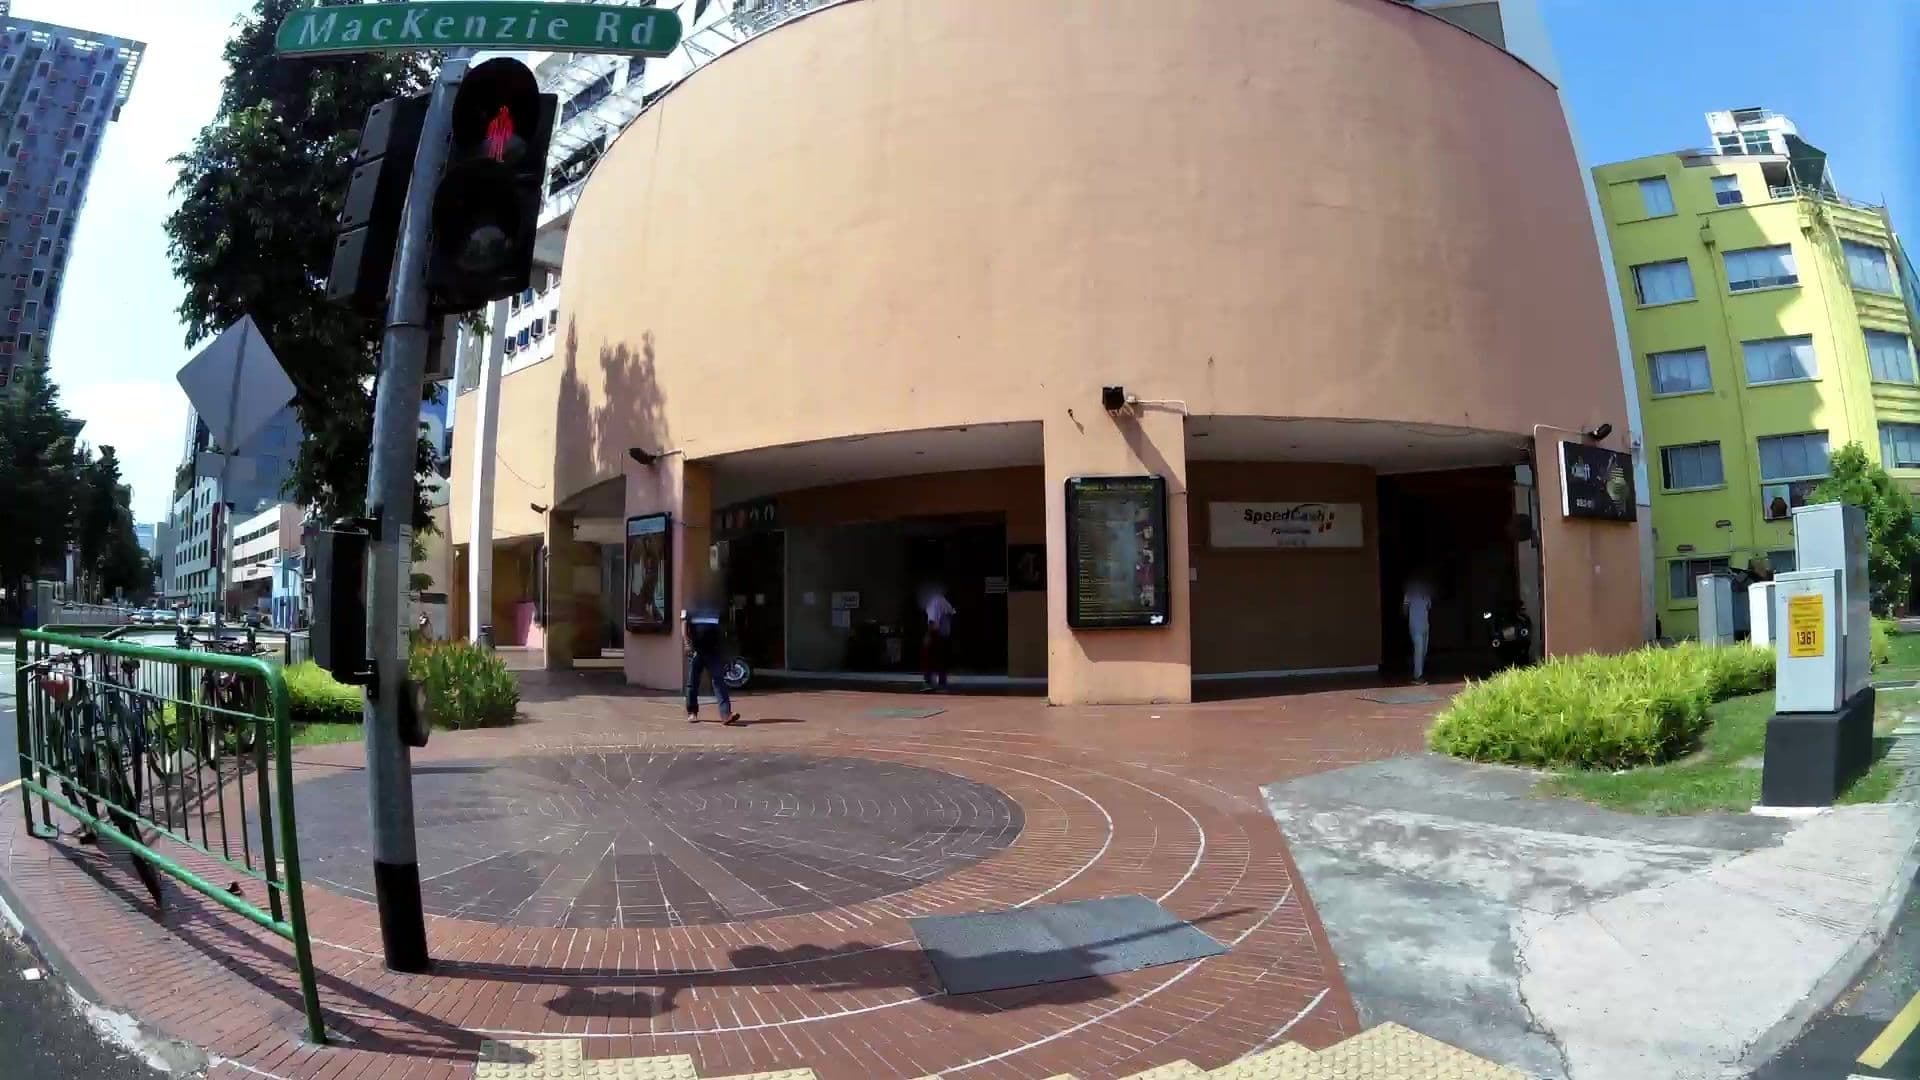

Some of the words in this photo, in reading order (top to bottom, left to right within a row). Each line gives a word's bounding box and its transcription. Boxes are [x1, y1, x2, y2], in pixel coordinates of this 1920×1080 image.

[298, 7, 569, 45] MacKenzie
[594, 10, 655, 46] Rd
[1796, 631, 1817, 645] 1361
